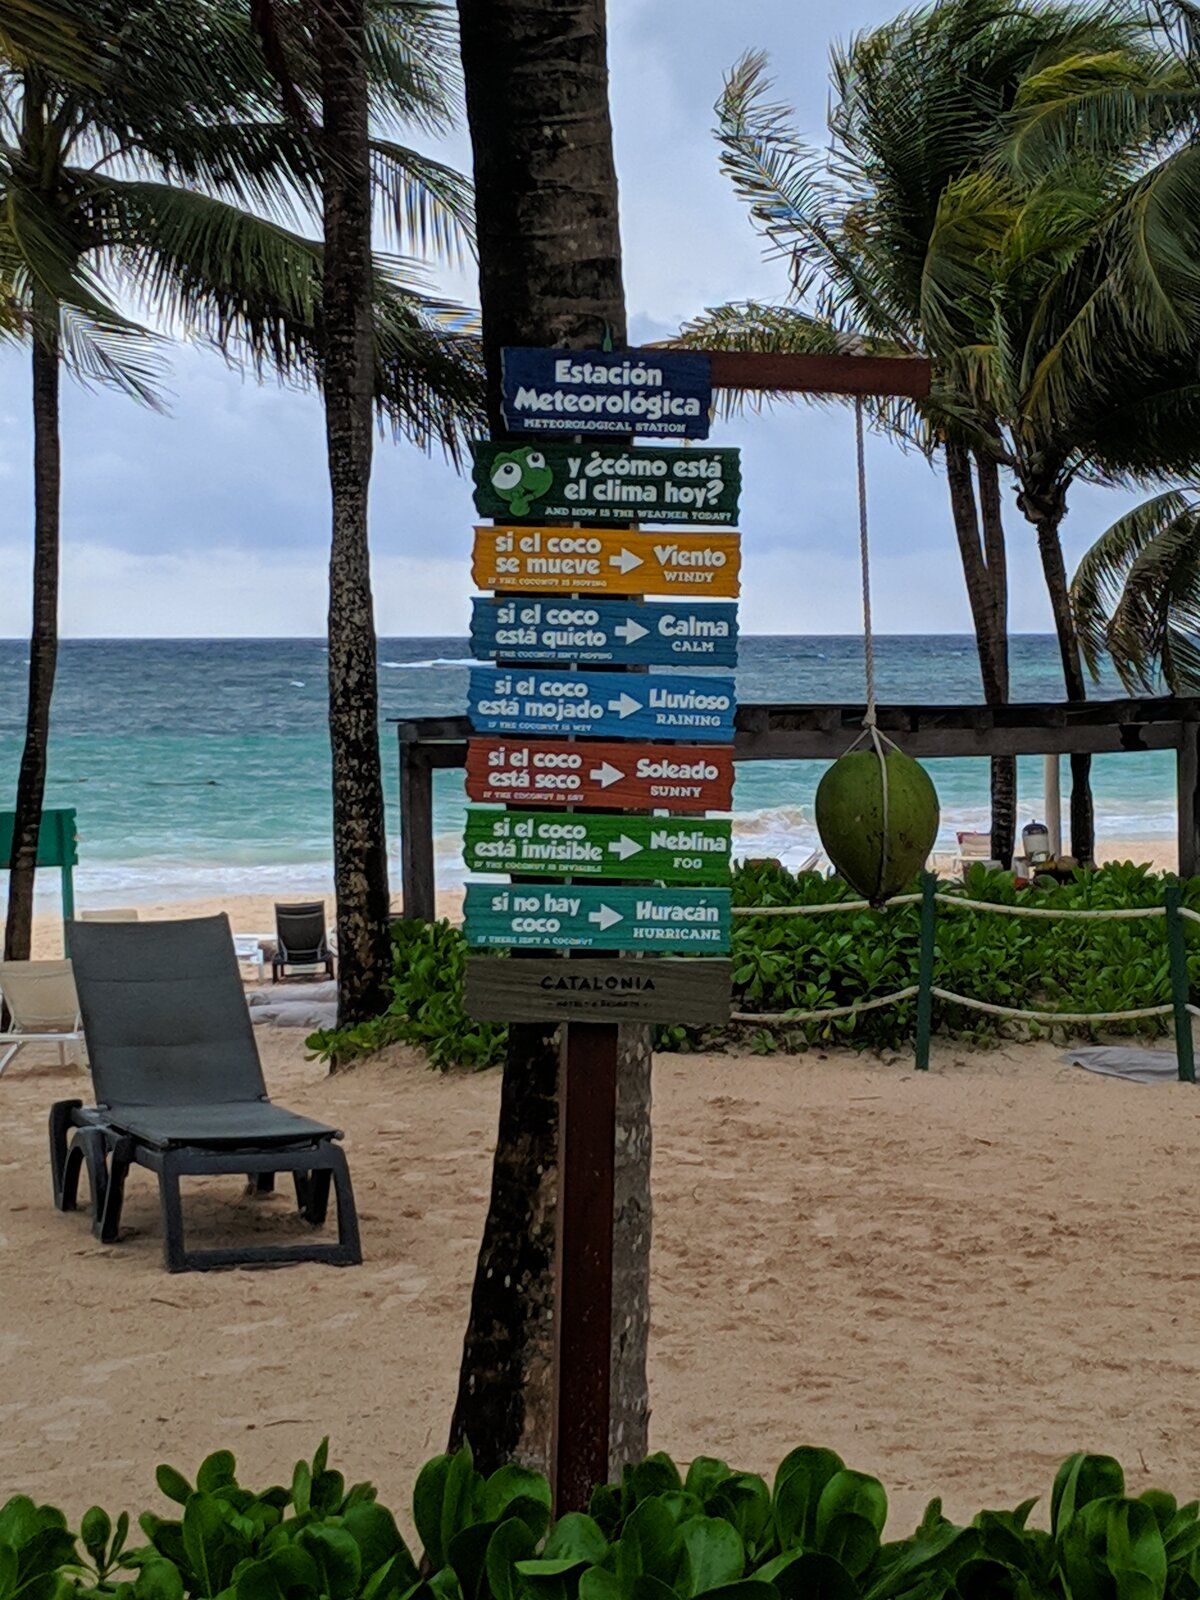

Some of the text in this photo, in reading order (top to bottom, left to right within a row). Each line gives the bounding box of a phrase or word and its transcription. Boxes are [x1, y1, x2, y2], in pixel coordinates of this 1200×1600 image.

[554, 359, 663, 386] Estación
[513, 386, 700, 420] Meteorológica
[523, 418, 686, 432] METEOROLOGICAL STATION
[567, 457, 582, 478] y
[672, 455, 722, 478] está
[563, 478, 725, 508] el clima hoy?
[544, 507, 569, 516] AND
[572, 508, 597, 516] HOW
[599, 509, 610, 517] IS
[613, 509, 634, 518] THE
[637, 510, 688, 520] WEATHER
[495, 532, 602, 554] si el coco
[496, 557, 600, 575] se mueve
[653, 544, 727, 568] Viento
[664, 571, 715, 583] WINDY
[497, 603, 599, 626] si el coco
[658, 615, 729, 637] Calma
[495, 626, 607, 649] está quieto
[672, 641, 714, 652] CALM
[494, 676, 588, 697] si el coco
[477, 698, 604, 721] está mojado
[649, 688, 730, 711] Lluvioso
[656, 714, 721, 726] RAINING
[488, 747, 583, 769] si el coco
[488, 769, 581, 789] está seco
[636, 758, 719, 781] Soleado
[650, 786, 702, 798] SUNNY
[492, 818, 587, 840] si el coco
[474, 839, 603, 861] está invisible
[651, 830, 727, 852] Neblina
[673, 858, 702, 869] FOG
[491, 892, 581, 917] si no hay
[636, 900, 719, 922] Huracán
[511, 917, 561, 933] coco
[633, 928, 721, 941] HURRICANE
[541, 975, 656, 991] CATALONIA
